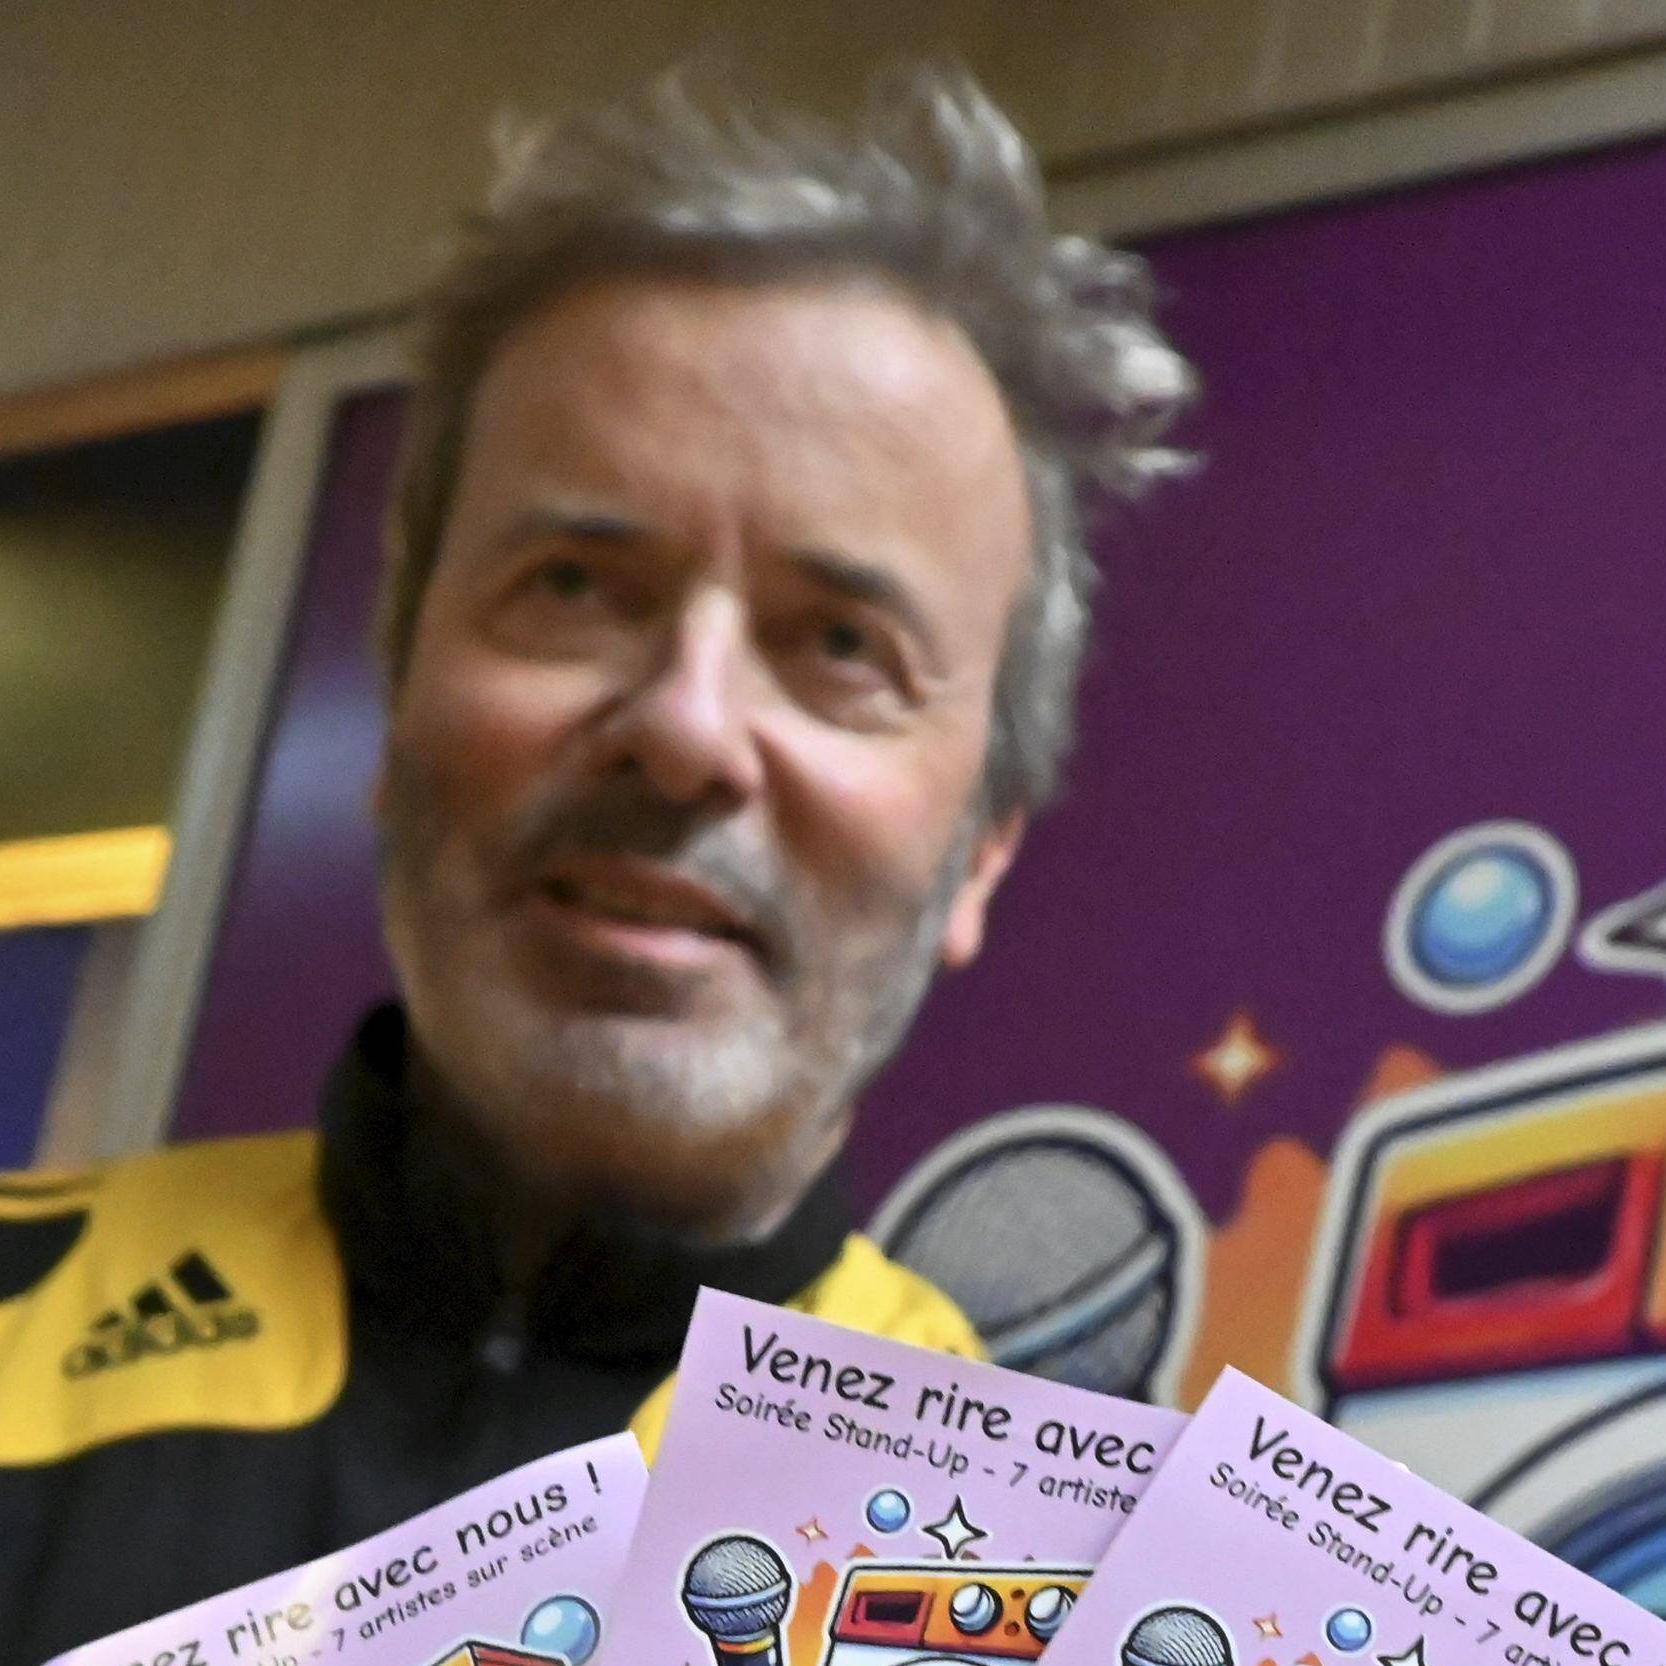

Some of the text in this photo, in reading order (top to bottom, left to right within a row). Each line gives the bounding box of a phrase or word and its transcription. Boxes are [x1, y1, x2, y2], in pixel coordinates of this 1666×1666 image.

[715, 1383, 811, 1433] Soirée
[824, 1412, 969, 1479] Stand-Up
[1009, 1461, 1028, 1487] 7
[741, 1324, 1155, 1475] Venez rire avec
[225, 1604, 314, 1654] rire
[333, 1544, 439, 1612] avec
[455, 1481, 570, 1555] nous
[587, 1461, 603, 1495] !
[332, 1627, 347, 1654] 7
[359, 1579, 459, 1641] artistes
[467, 1553, 511, 1590] sur
[520, 1512, 600, 1564] scène
[1209, 1461, 1301, 1532] Soirée
[1308, 1521, 1444, 1619] Stand-Up
[1476, 1619, 1498, 1645] 7
[1249, 1415, 1393, 1533] Venez
[1406, 1523, 1499, 1596] rire
